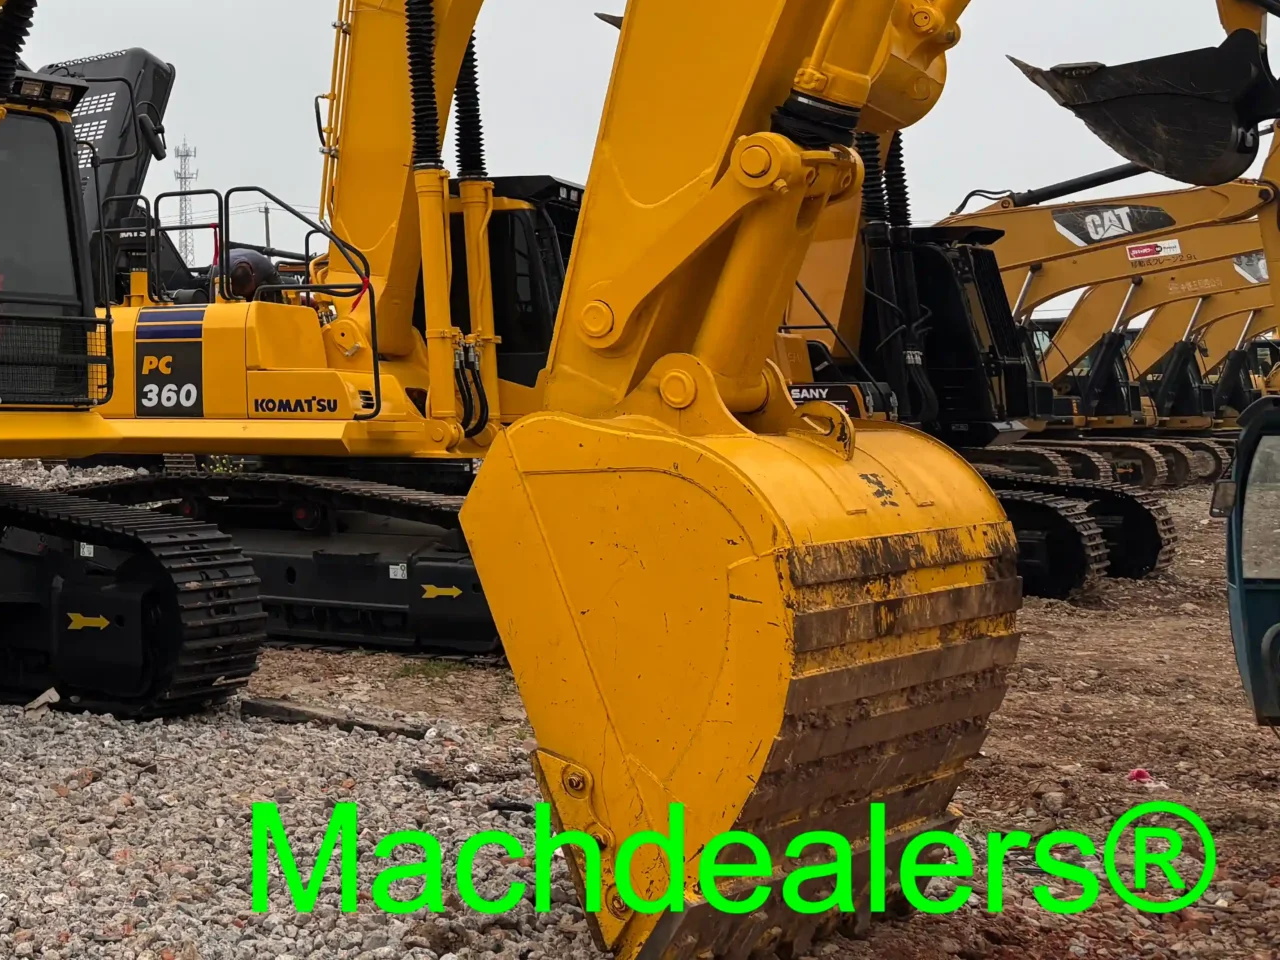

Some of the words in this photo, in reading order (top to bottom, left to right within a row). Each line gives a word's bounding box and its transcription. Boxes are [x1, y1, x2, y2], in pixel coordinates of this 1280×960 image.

[1085, 206, 1133, 240] CAT
[141, 355, 173, 375] PC
[141, 383, 198, 408] 360
[790, 388, 829, 399] SANY
[254, 395, 338, 413] KOMATSU
